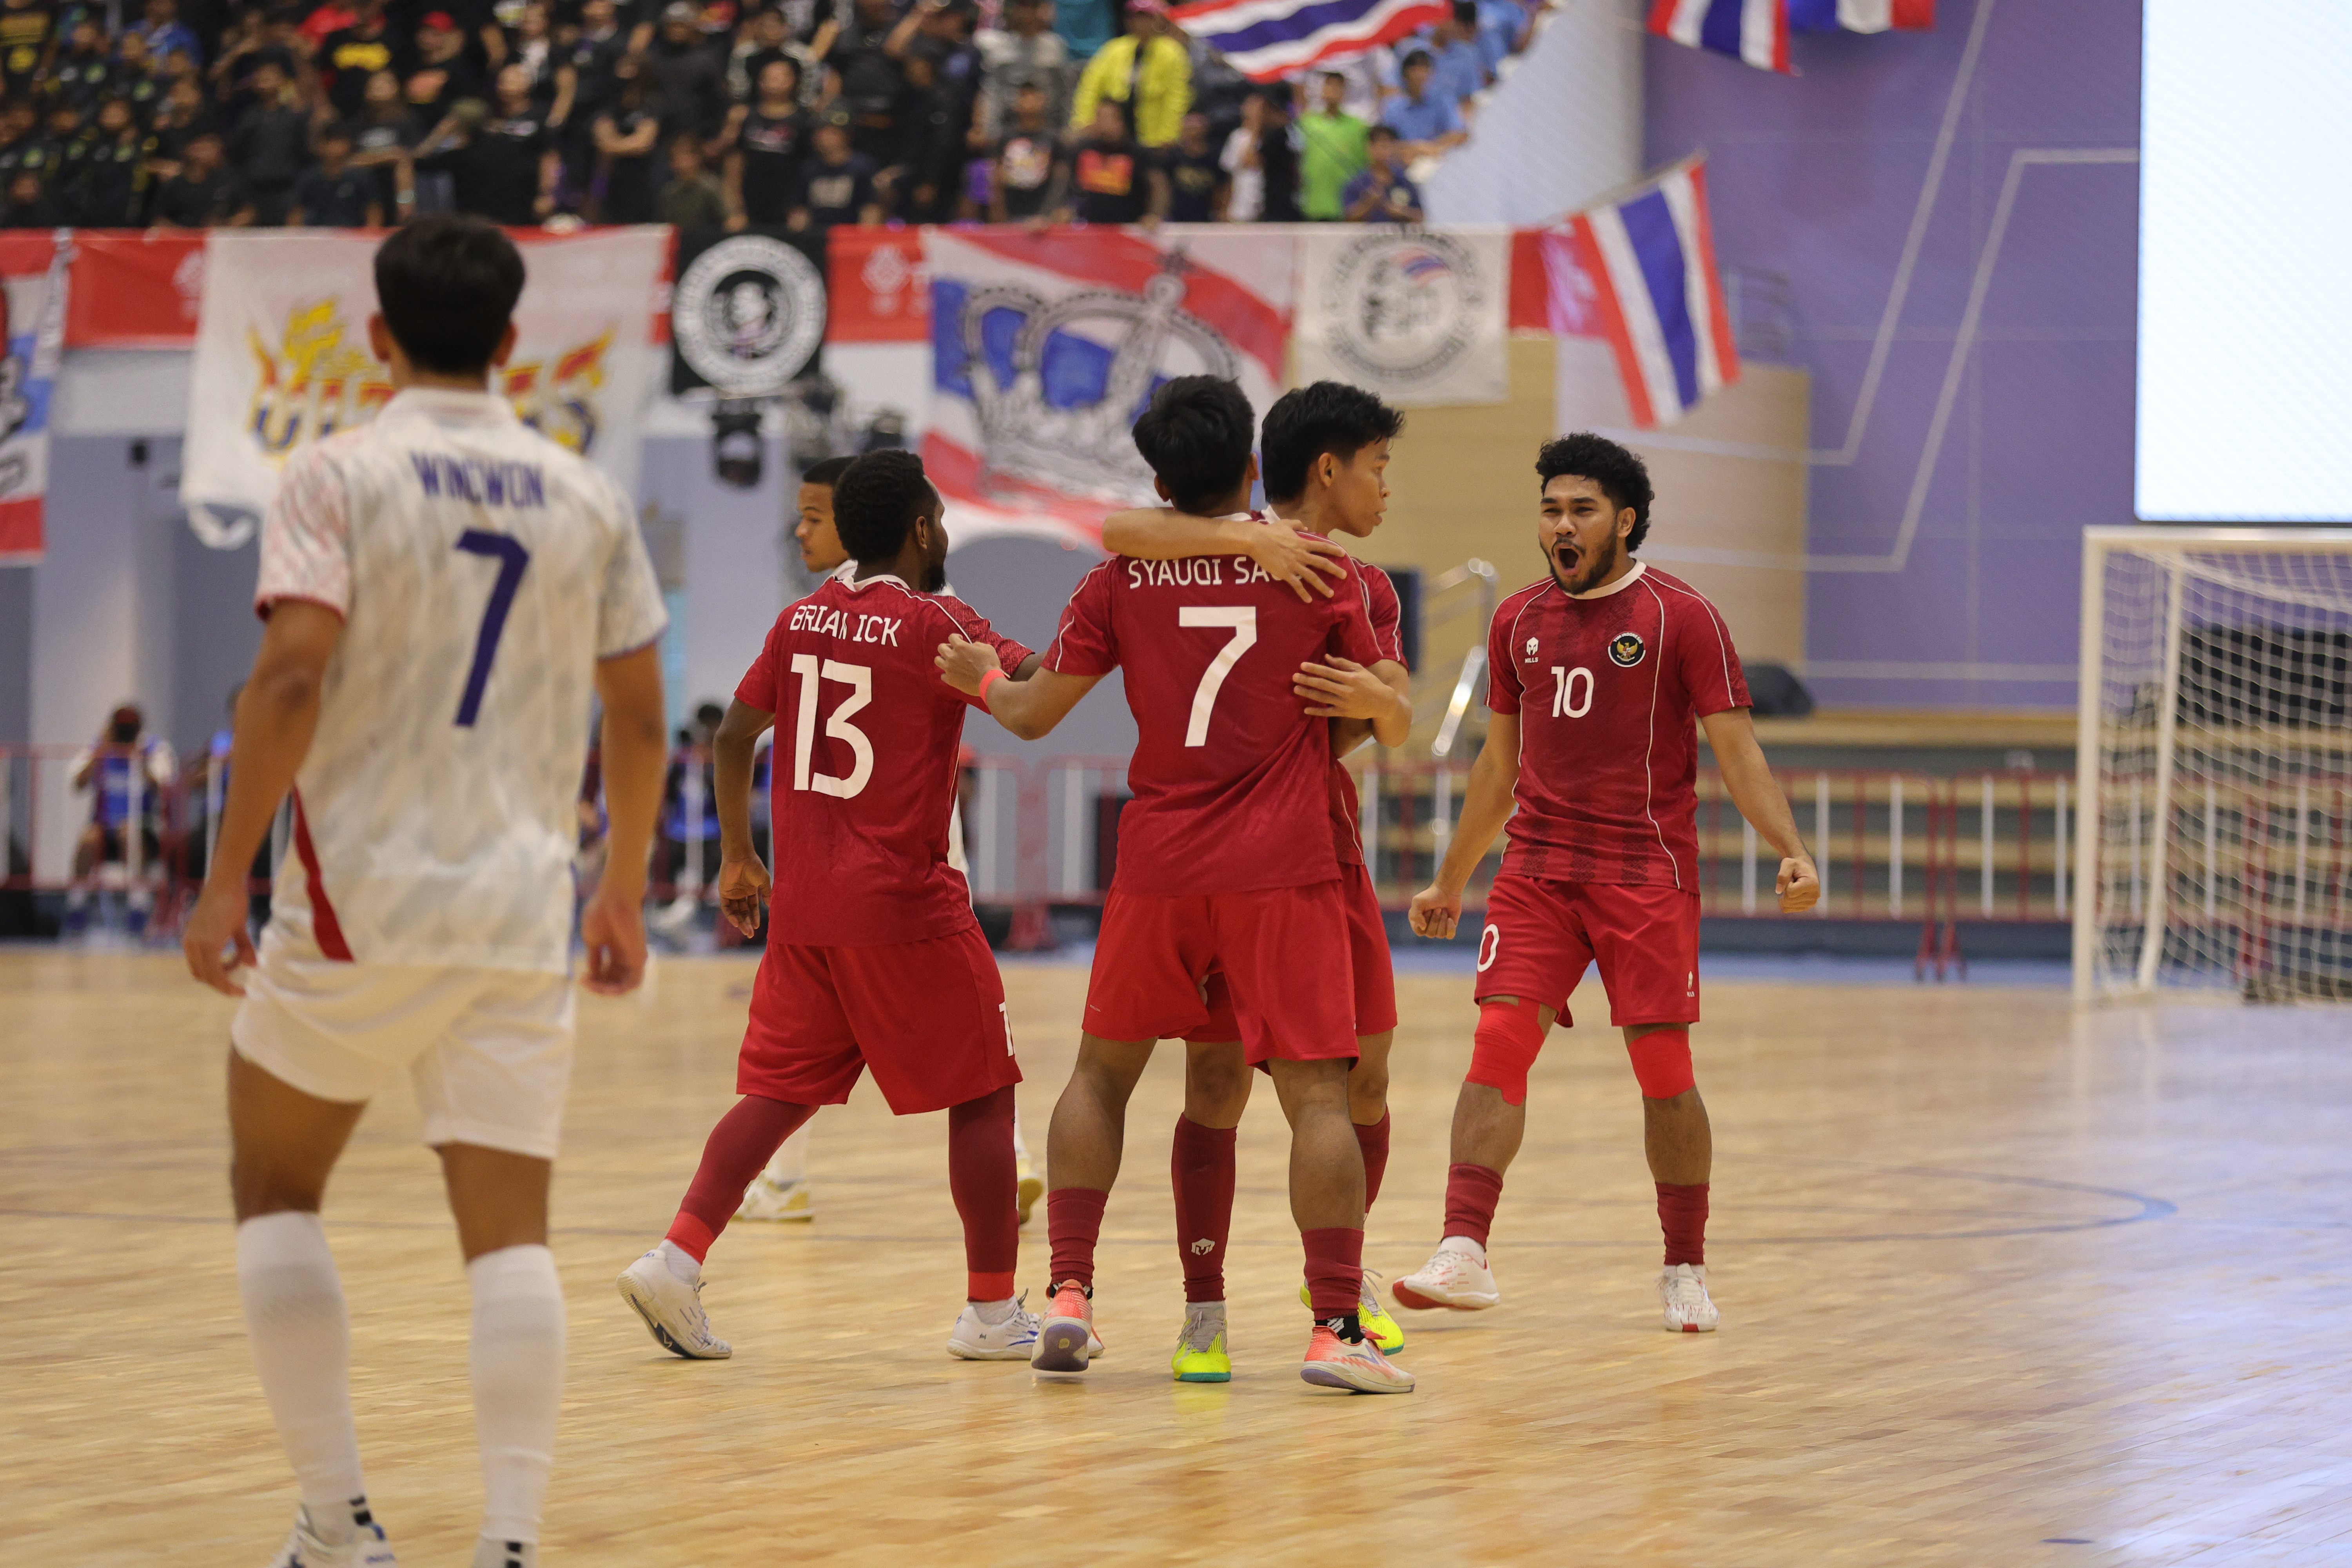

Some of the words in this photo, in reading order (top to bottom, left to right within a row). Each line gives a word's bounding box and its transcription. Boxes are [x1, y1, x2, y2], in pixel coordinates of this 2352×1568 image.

[1128, 558, 1222, 589] SYAUQI
[1234, 556, 1302, 584] SA
[454, 527, 530, 727] 7
[853, 615, 902, 647] ICK
[1179, 606, 1257, 747] 7
[1551, 666, 1594, 718] 10
[790, 653, 874, 800] 13
[998, 1001, 1016, 1057] 1
